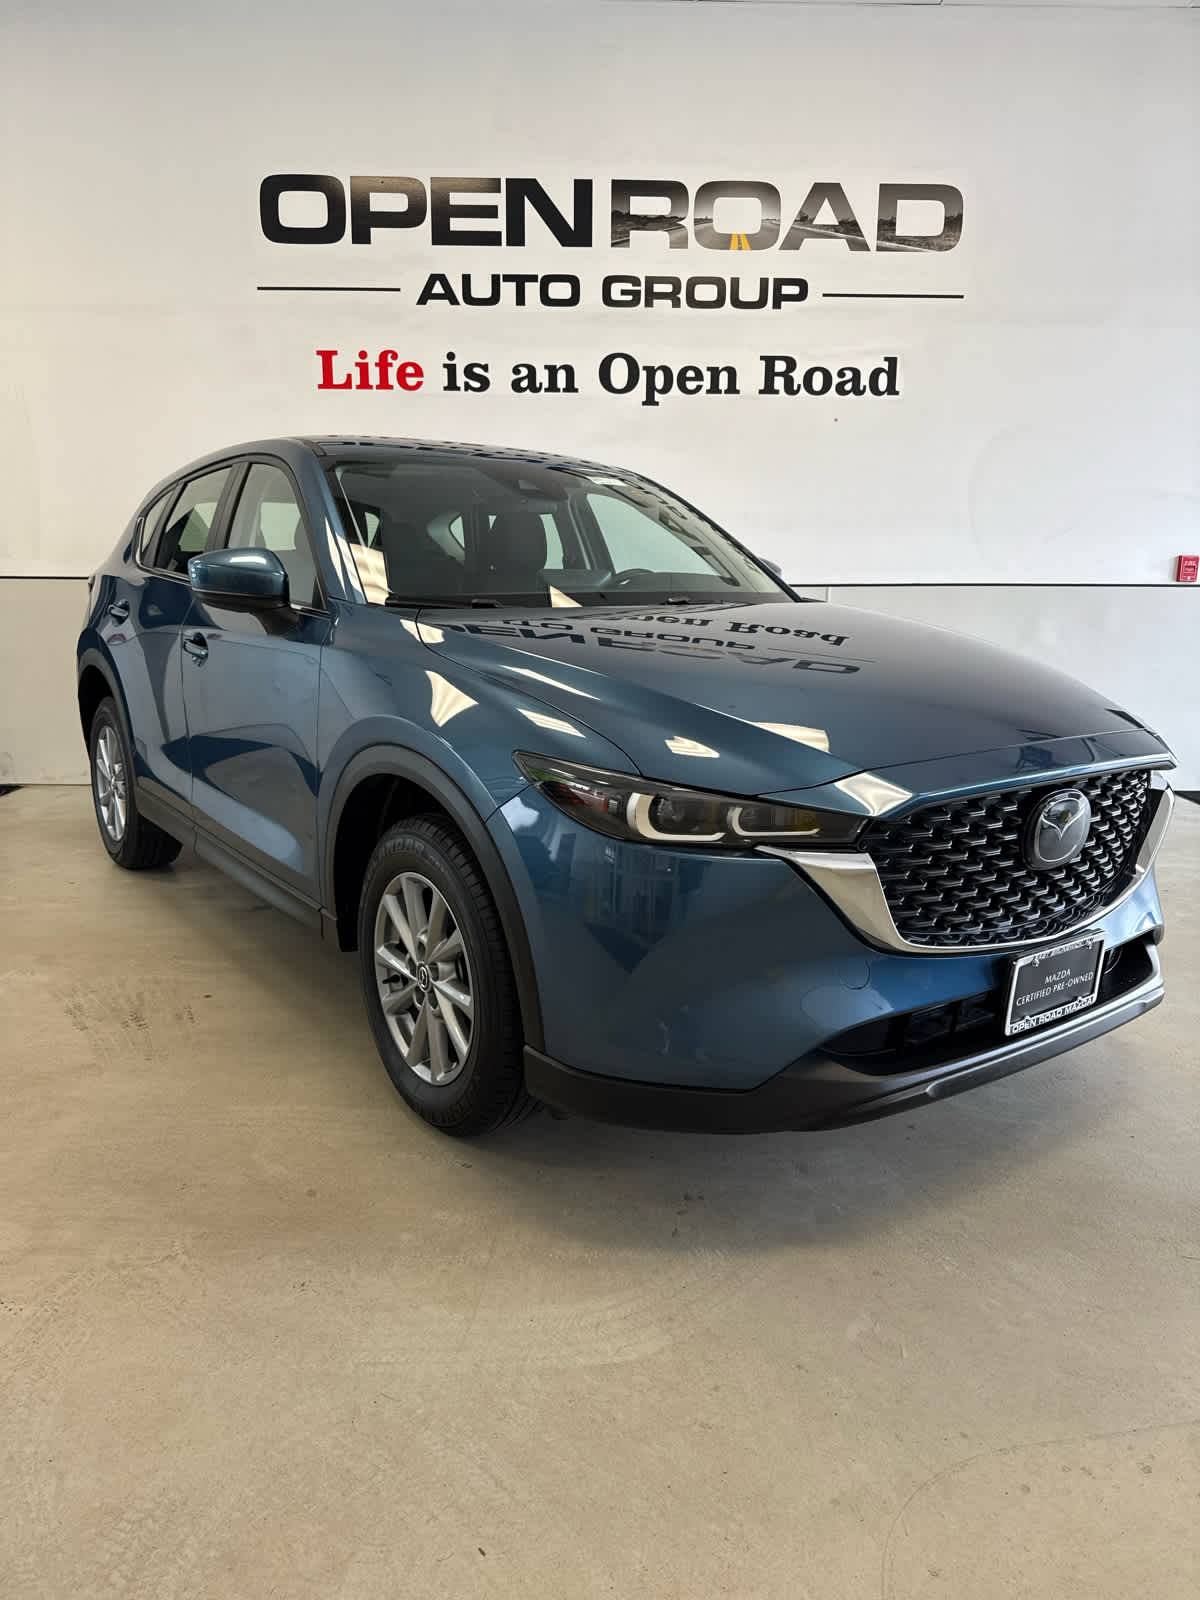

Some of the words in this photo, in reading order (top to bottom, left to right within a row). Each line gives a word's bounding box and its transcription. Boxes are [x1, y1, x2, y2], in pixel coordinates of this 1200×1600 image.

[259, 173, 594, 248] OPEN
[610, 179, 964, 253] ROAD
[415, 273, 581, 307] AUTO
[601, 274, 809, 310] GROUP
[315, 349, 425, 392] Life
[442, 351, 491, 393] is
[510, 363, 579, 394] an
[598, 352, 741, 407] Open
[758, 355, 900, 397] Road
[1016, 987, 1052, 1006] CERTIFIED
[1053, 972, 1094, 992] PRE-OWNED
[1044, 968, 1071, 984] MAZDA
[1012, 1018, 1037, 1033] OPEN
[1038, 1009, 1063, 1024] ROAD
